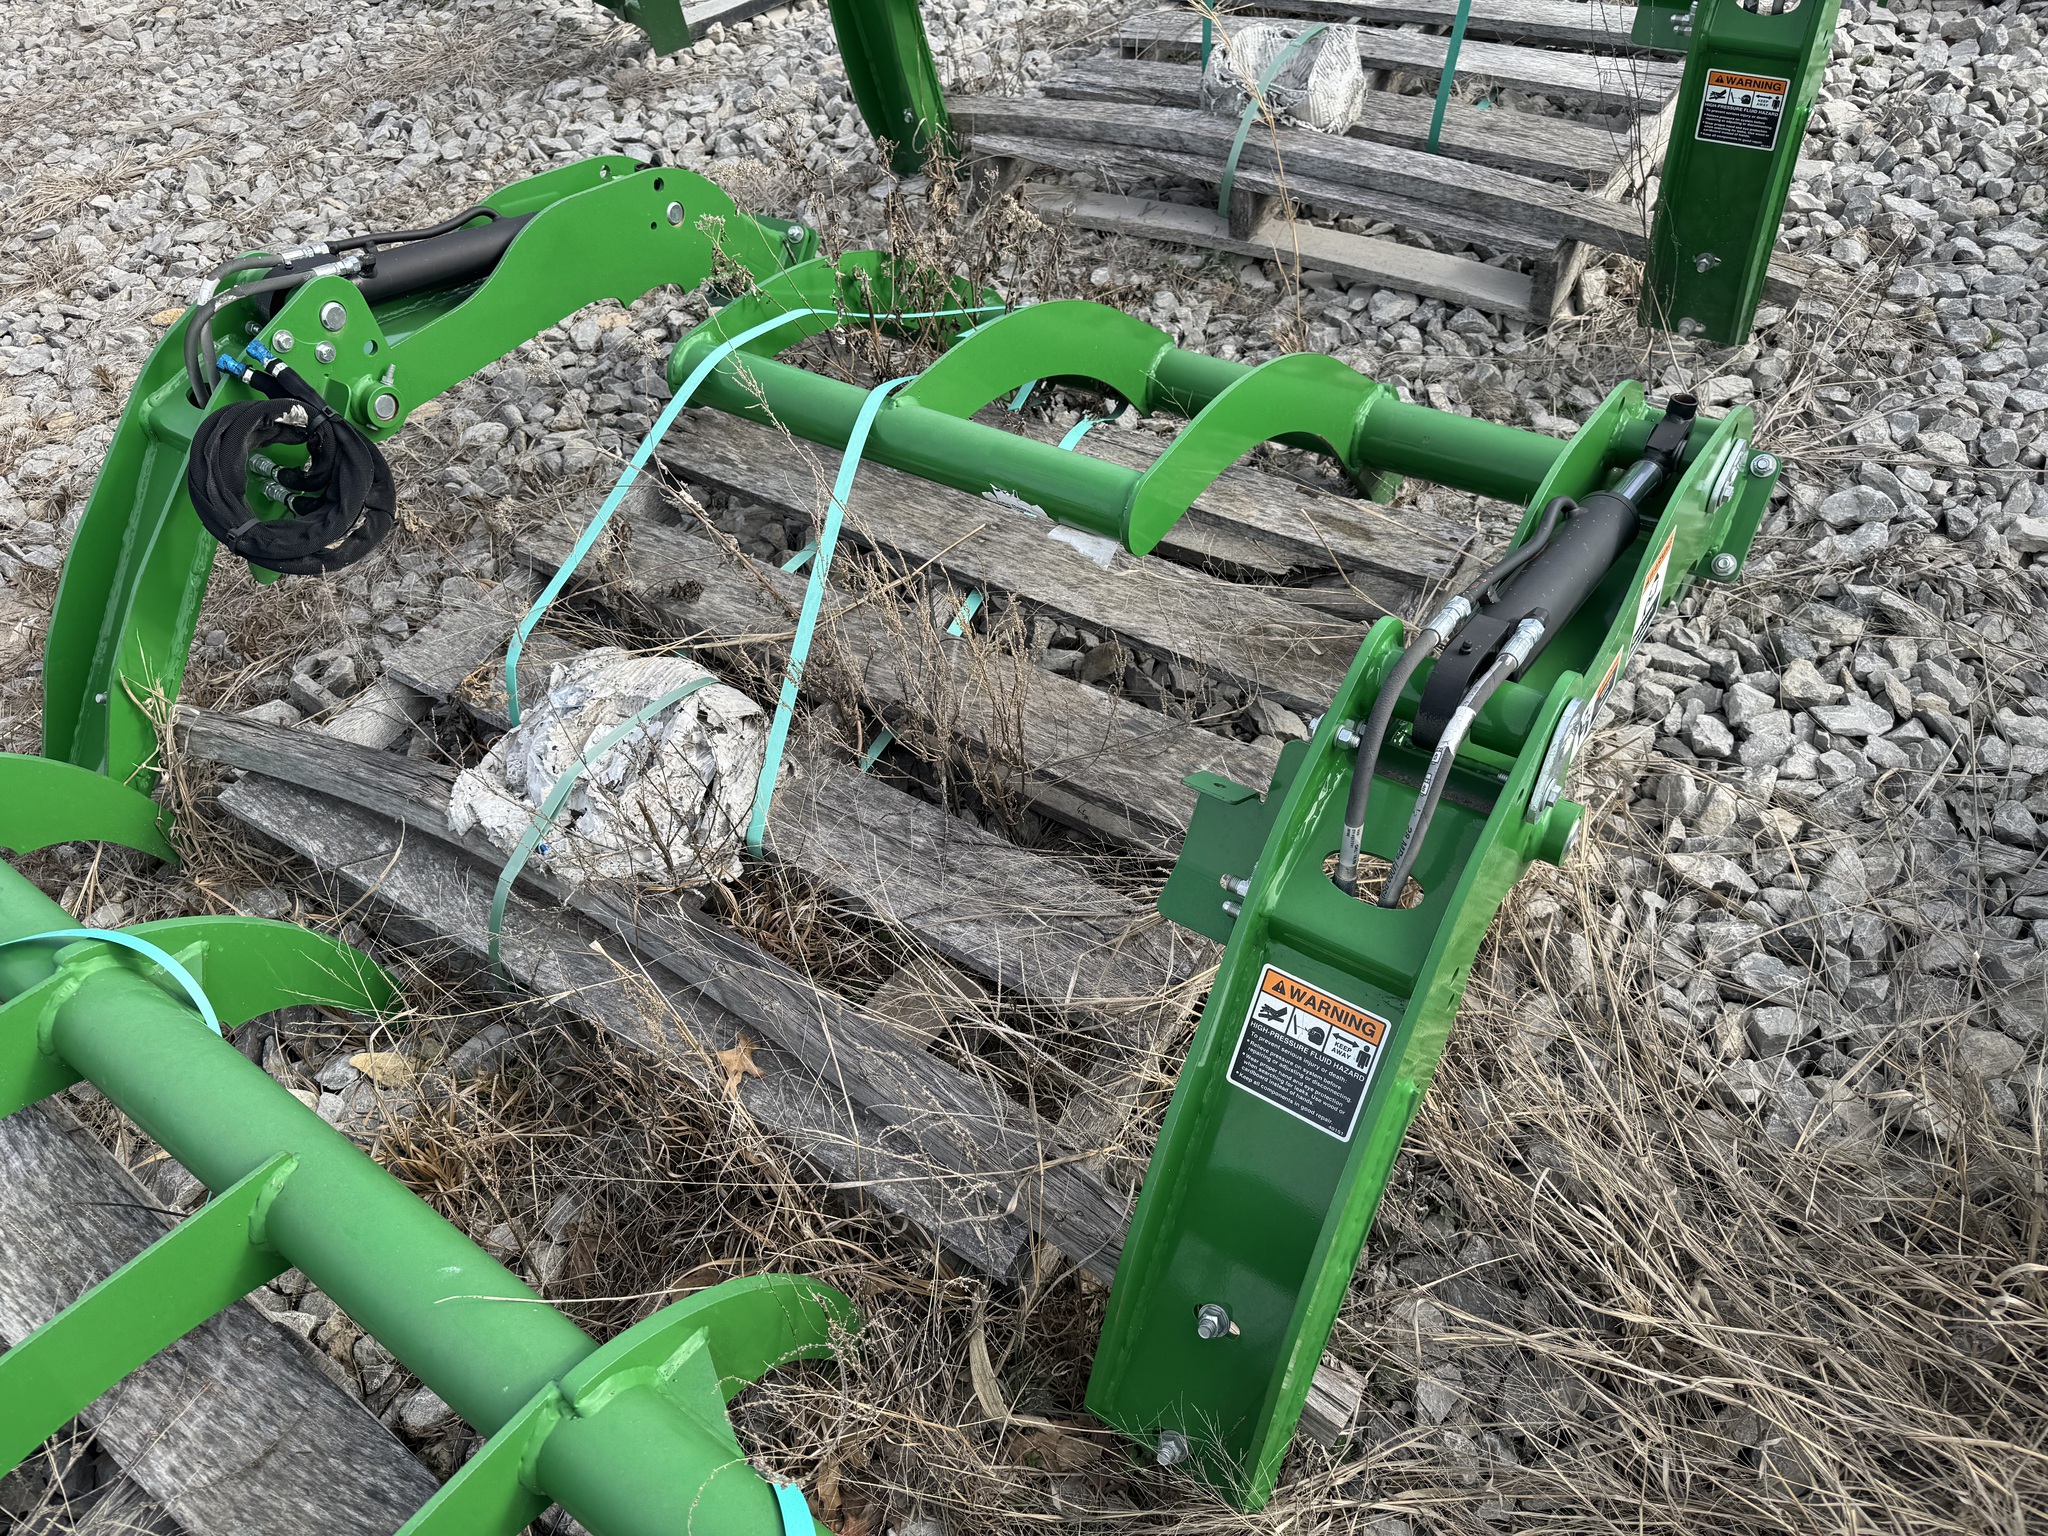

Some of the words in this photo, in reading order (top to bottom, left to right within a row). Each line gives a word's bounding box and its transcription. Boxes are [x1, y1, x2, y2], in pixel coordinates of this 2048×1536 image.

[1704, 102, 1743, 111] HIGH-PRESSURE
[1726, 76, 1781, 91] WARNING
[1290, 985, 1376, 1038] WARNING
[1249, 1020, 1309, 1054] HIGH-PRESSURE
[1309, 1050, 1332, 1066] FLUID
[1332, 1061, 1365, 1082] HAZARD
[1249, 1040, 1269, 1053] Relieve
[1269, 1050, 1293, 1067] pressure
[1302, 1067, 1322, 1081] system
[1323, 1077, 1341, 1090] before
[1258, 1036, 1280, 1050] prevent
[1280, 1046, 1302, 1061] serious
[1302, 1057, 1320, 1070] injury
[1328, 1070, 1347, 1083] death:
[1331, 1046, 1351, 1060] AWAY
[1334, 1041, 1352, 1053] KEEP
[1238, 1071, 1252, 1083] Keep
[1260, 1083, 1293, 1105] components
[1299, 1104, 1315, 1116] good
[1315, 1112, 1333, 1125] repair.
[1241, 1064, 1268, 1082] cardboard
[1268, 1078, 1288, 1093] instead
[1295, 1092, 1314, 1106] hands.
[1243, 1058, 1258, 1070] when
[1257, 1066, 1284, 1085] searching
[1284, 1080, 1293, 1088] for
[1293, 1084, 1310, 1097] leaks.
[1310, 1093, 1322, 1103] Use
[1322, 1099, 1338, 1111] wood
[1244, 1053, 1259, 1064] Wear
[1258, 1061, 1277, 1074] proper
[1277, 1069, 1292, 1081] hand
[1292, 1077, 1303, 1087] and
[1303, 1083, 1314, 1093] eye
[1314, 1088, 1343, 1108] protection
[1247, 1046, 1271, 1062] repairing
[1278, 1061, 1304, 1079] adjusting
[1310, 1078, 1352, 1104] disconnecting.
